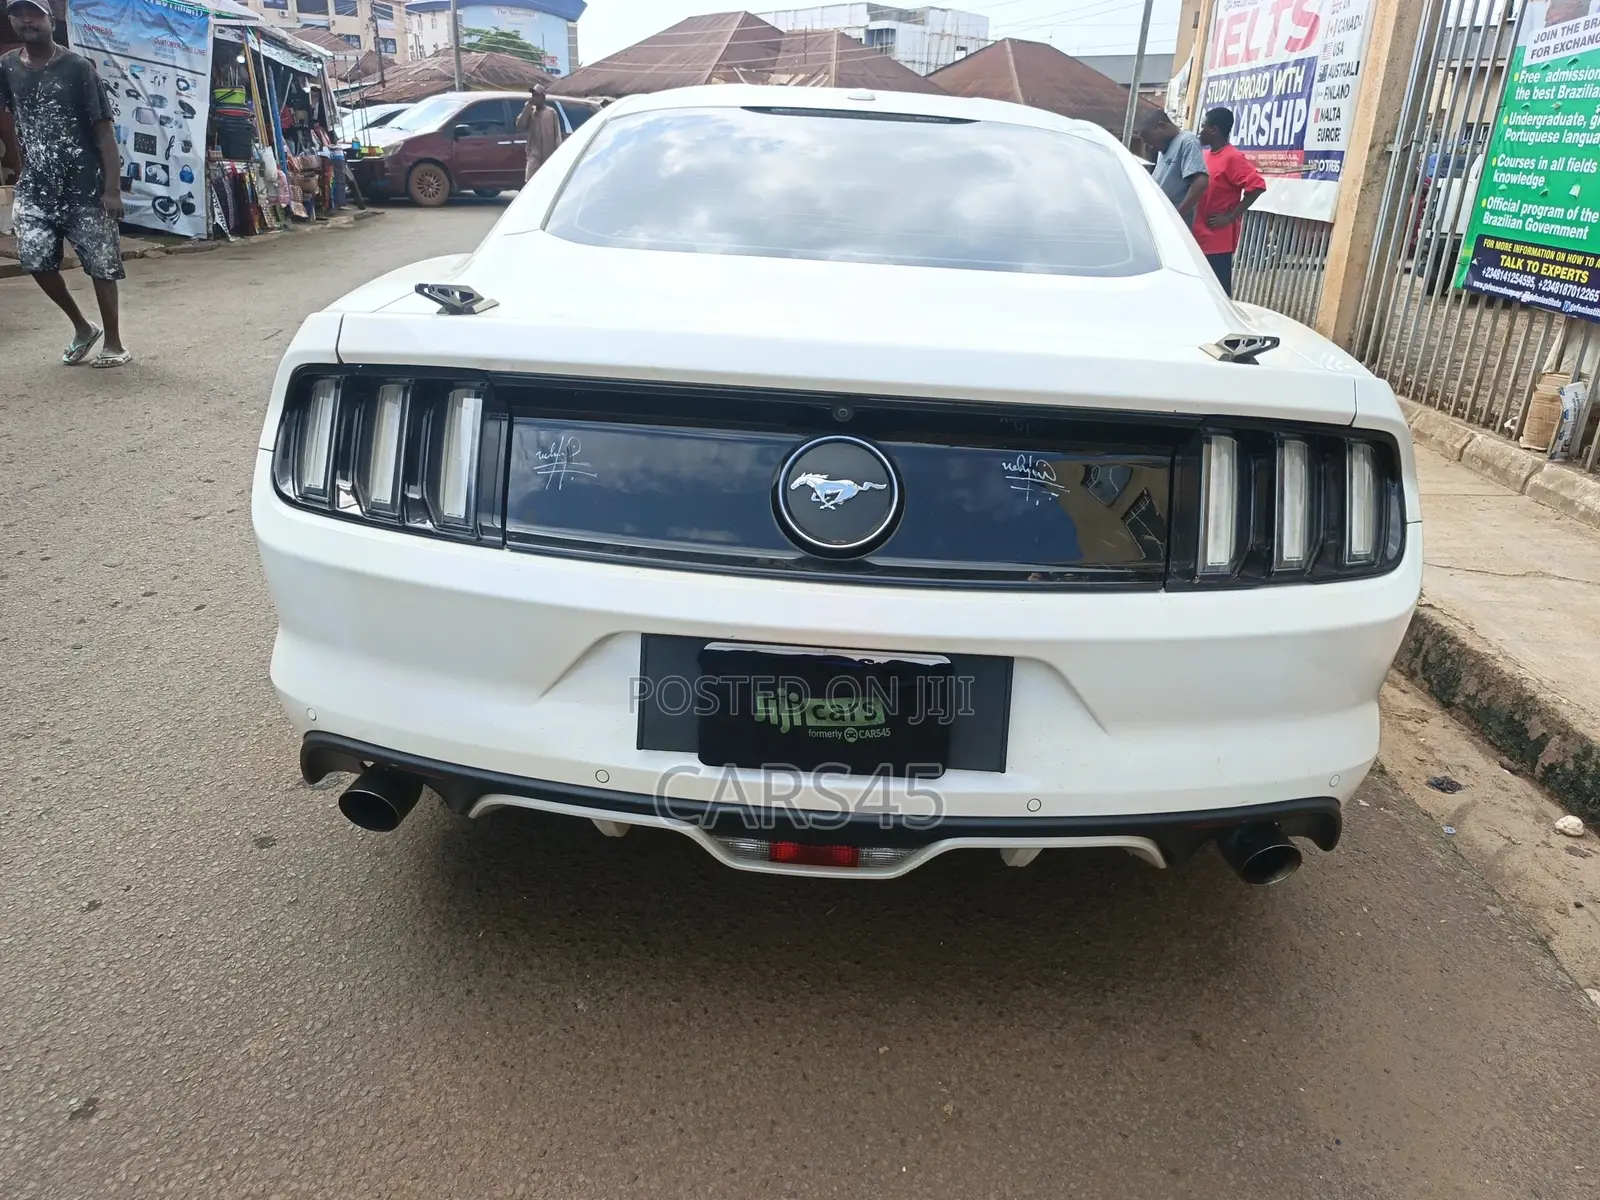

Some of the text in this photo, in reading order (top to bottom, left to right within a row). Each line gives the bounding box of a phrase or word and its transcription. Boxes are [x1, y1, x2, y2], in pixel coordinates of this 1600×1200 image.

[1209, 0, 1320, 70] IELTS
[1534, 28, 1558, 44] JOIN
[1561, 22, 1581, 36] THE
[1530, 46, 1550, 60] FOR
[1206, 64, 1306, 104] STUDY ABROAD WITH
[1519, 70, 1540, 84] Free
[1323, 84, 1351, 101] FINLAND
[1515, 86, 1530, 100] the
[1532, 86, 1556, 100] best
[1199, 98, 1308, 147] LARSHIP
[1319, 108, 1342, 122] MALTA
[1508, 112, 1587, 130] Undergraduate,
[1504, 128, 1560, 146] Portuguese
[1497, 154, 1598, 174] Courses in all fields
[1492, 169, 1546, 190] knowledge
[1486, 196, 1599, 224] Official program of the
[1482, 212, 1590, 240] Brazilian Government
[1483, 238, 1494, 248] FOR
[1494, 241, 1512, 252] MORE
[1513, 244, 1556, 259] INFORMATION
[1556, 251, 1566, 261] ON
[1567, 253, 1584, 265] HOW
[1585, 256, 1594, 267] TO
[1500, 254, 1590, 284] TALK TO EXPERTS
[1538, 279, 1600, 303] +2348187012265
